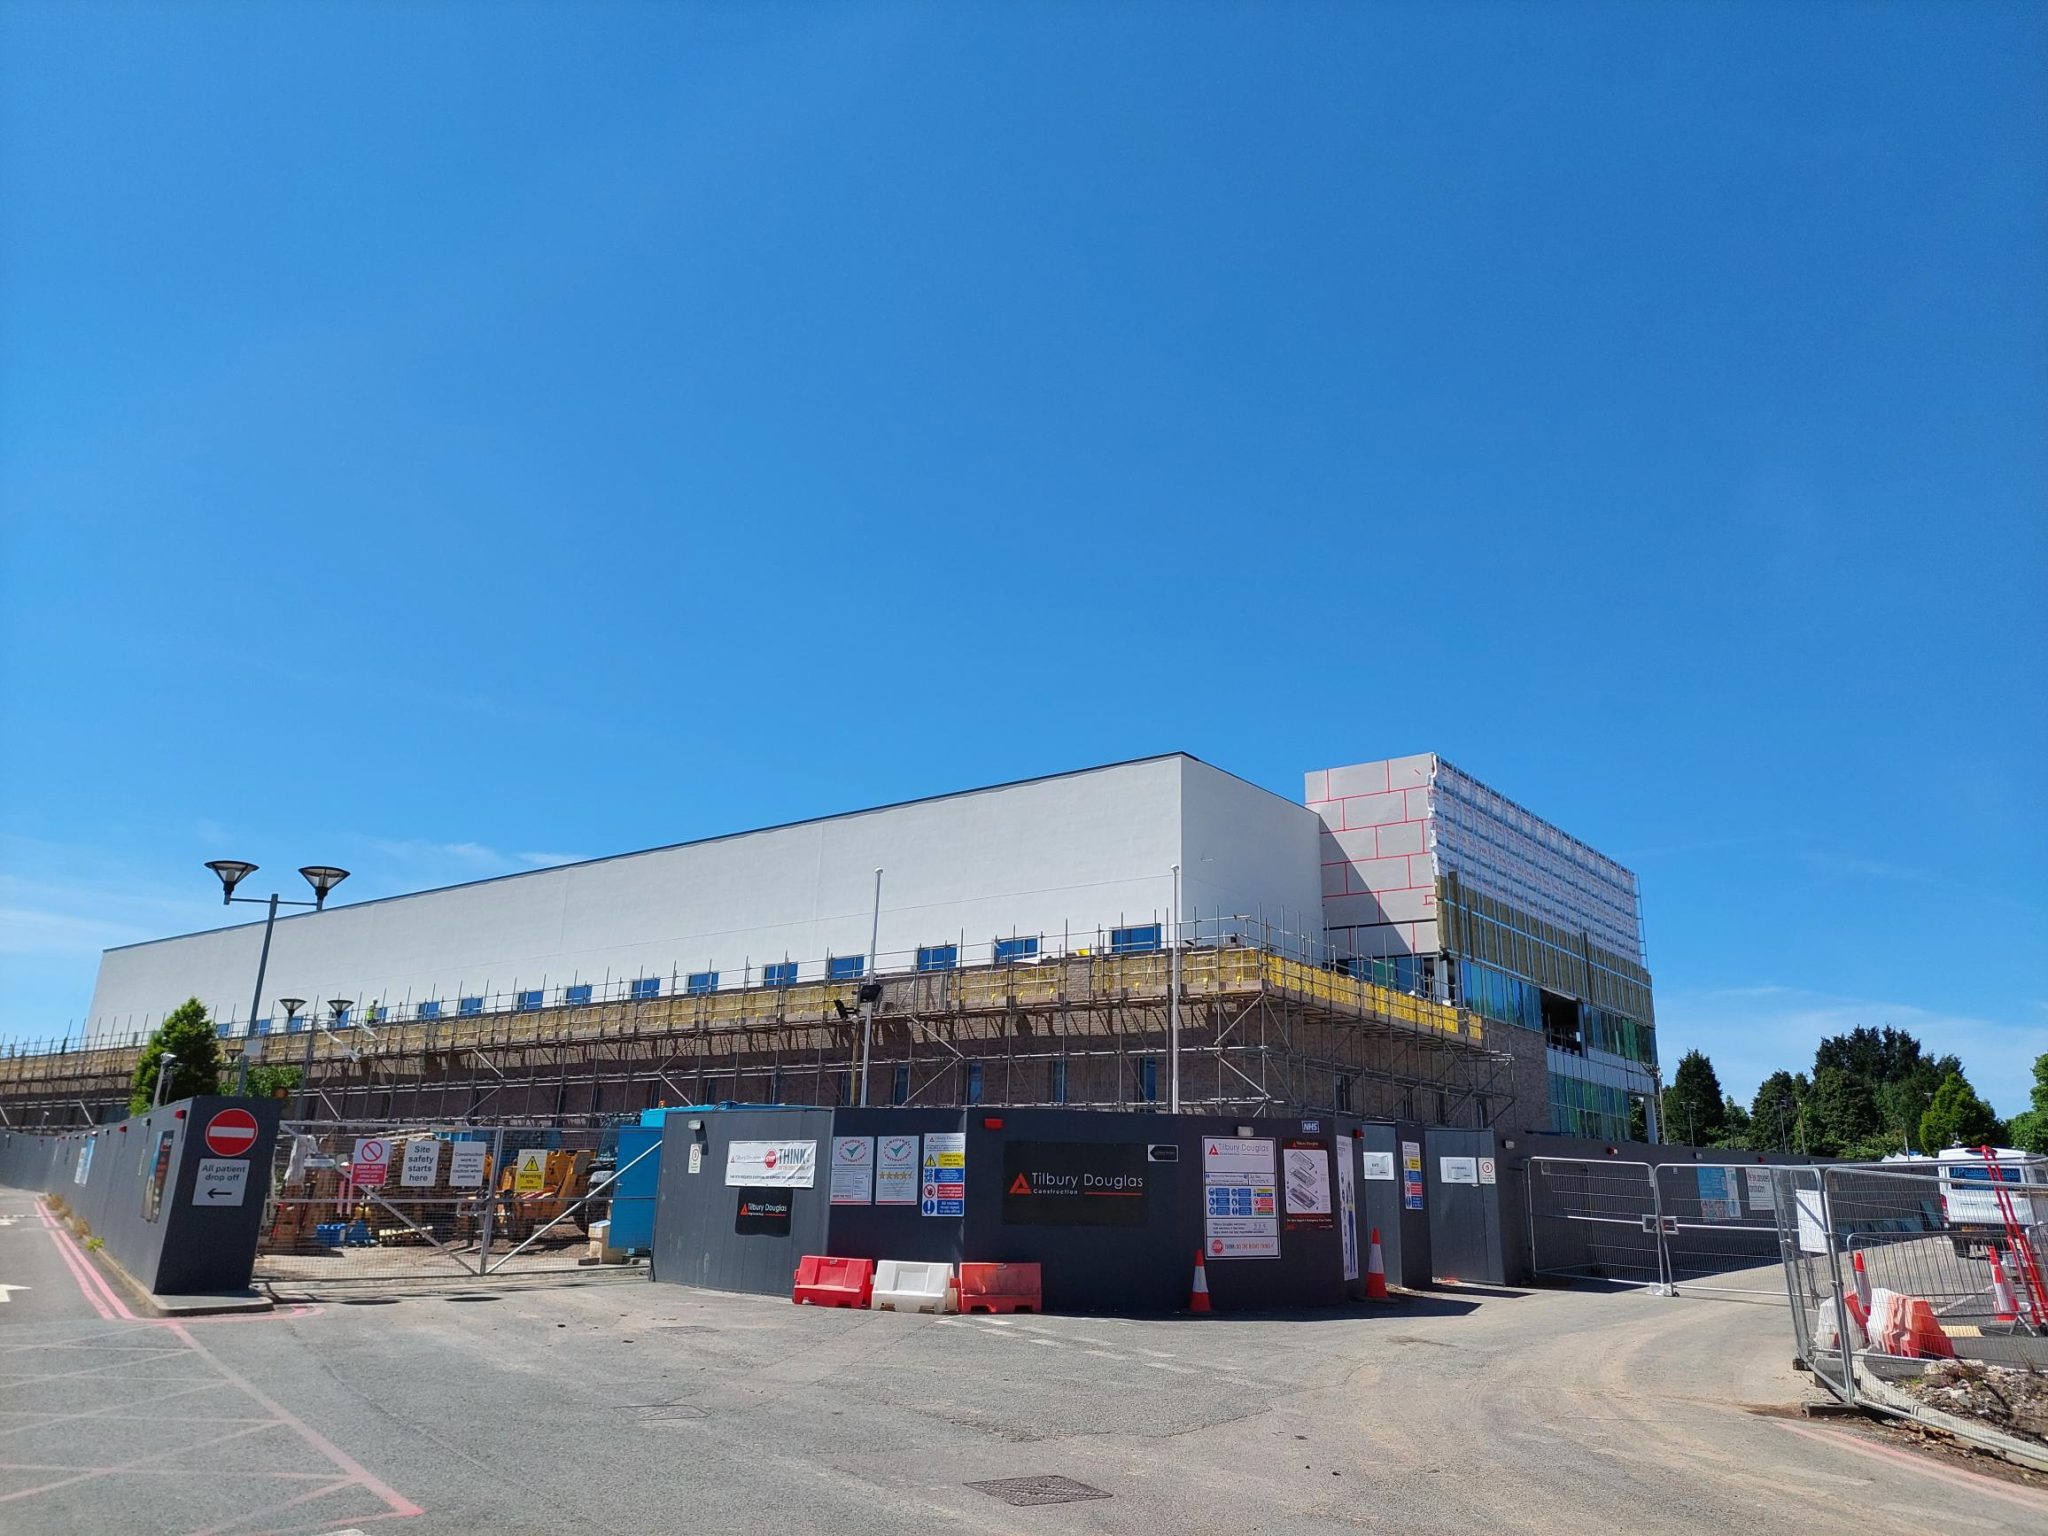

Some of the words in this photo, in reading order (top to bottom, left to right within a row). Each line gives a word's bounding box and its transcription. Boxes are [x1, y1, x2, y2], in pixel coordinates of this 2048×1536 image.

[1303, 1123, 1318, 1131] NHS
[414, 1145, 431, 1153] Site
[1241, 1144, 1269, 1153] Douglas
[409, 1155, 434, 1164] safety
[202, 1164, 214, 1172] All
[215, 1165, 246, 1174] patient
[205, 1174, 225, 1182] drop
[1032, 1172, 1078, 1188] Tilbury
[1084, 1173, 1143, 1190] Douglas
[748, 1203, 764, 1212] Tilbury
[765, 1203, 787, 1213] Douglas
